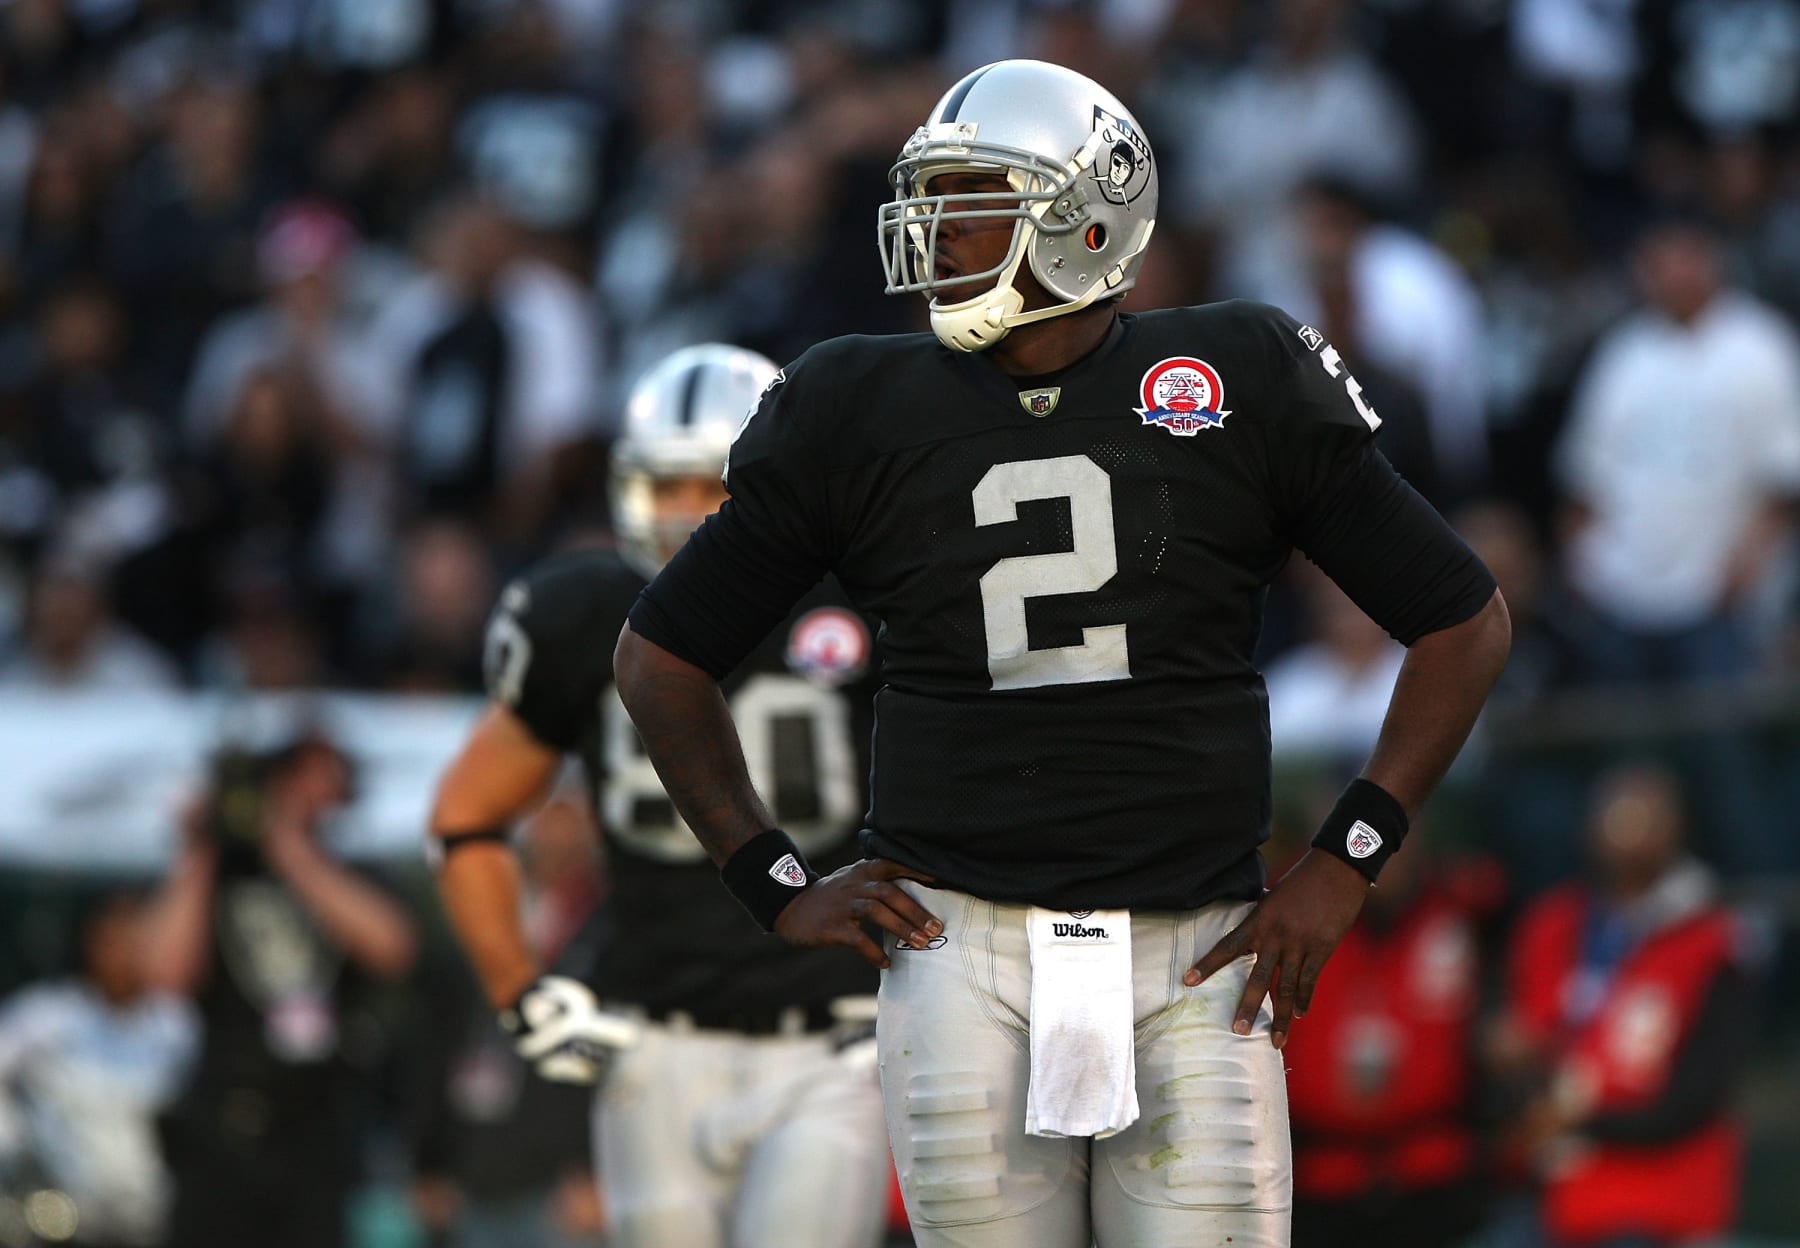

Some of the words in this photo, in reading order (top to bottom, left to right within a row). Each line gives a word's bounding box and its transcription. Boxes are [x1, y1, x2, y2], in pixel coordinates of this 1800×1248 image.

[1320, 344, 1382, 432] 2
[972, 454, 1133, 691] 2
[1352, 838, 1367, 854] NFL
[1356, 825, 1378, 846] EQUIPMENT
[1052, 923, 1106, 939] Wilson
